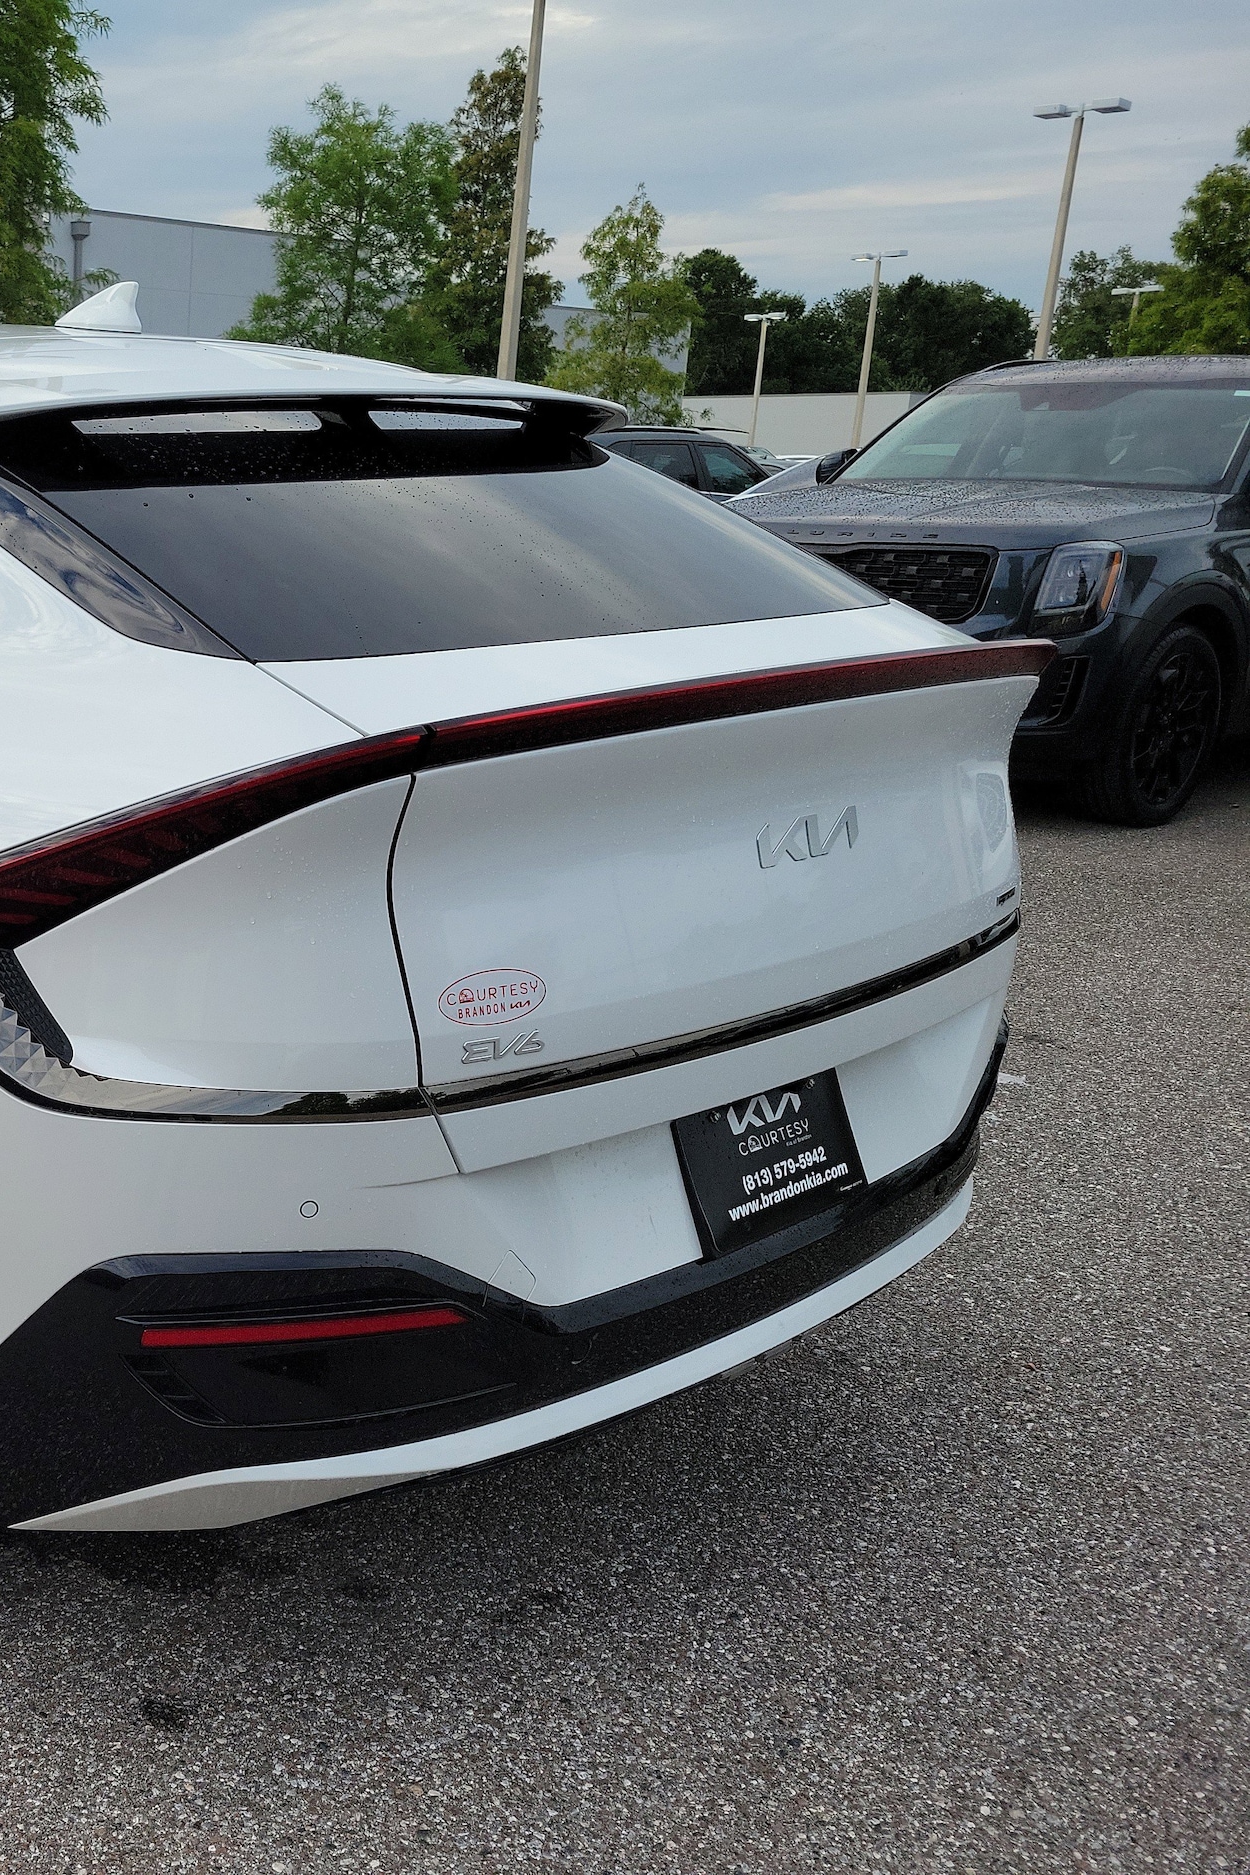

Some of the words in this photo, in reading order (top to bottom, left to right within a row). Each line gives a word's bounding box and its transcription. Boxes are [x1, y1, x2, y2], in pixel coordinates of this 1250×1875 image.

[786, 529, 939, 539] LURIDE
[756, 805, 859, 869] KIA
[446, 980, 538, 1006] COURTESY
[458, 1002, 506, 1019] BRANDON
[461, 1029, 545, 1065] EV6
[726, 1092, 801, 1136] KIA
[738, 1118, 810, 1156] COURTESY
[742, 1166, 774, 1196] (813)
[773, 1145, 827, 1180] 579-5942
[728, 1162, 849, 1222] www.brandonkia.com
